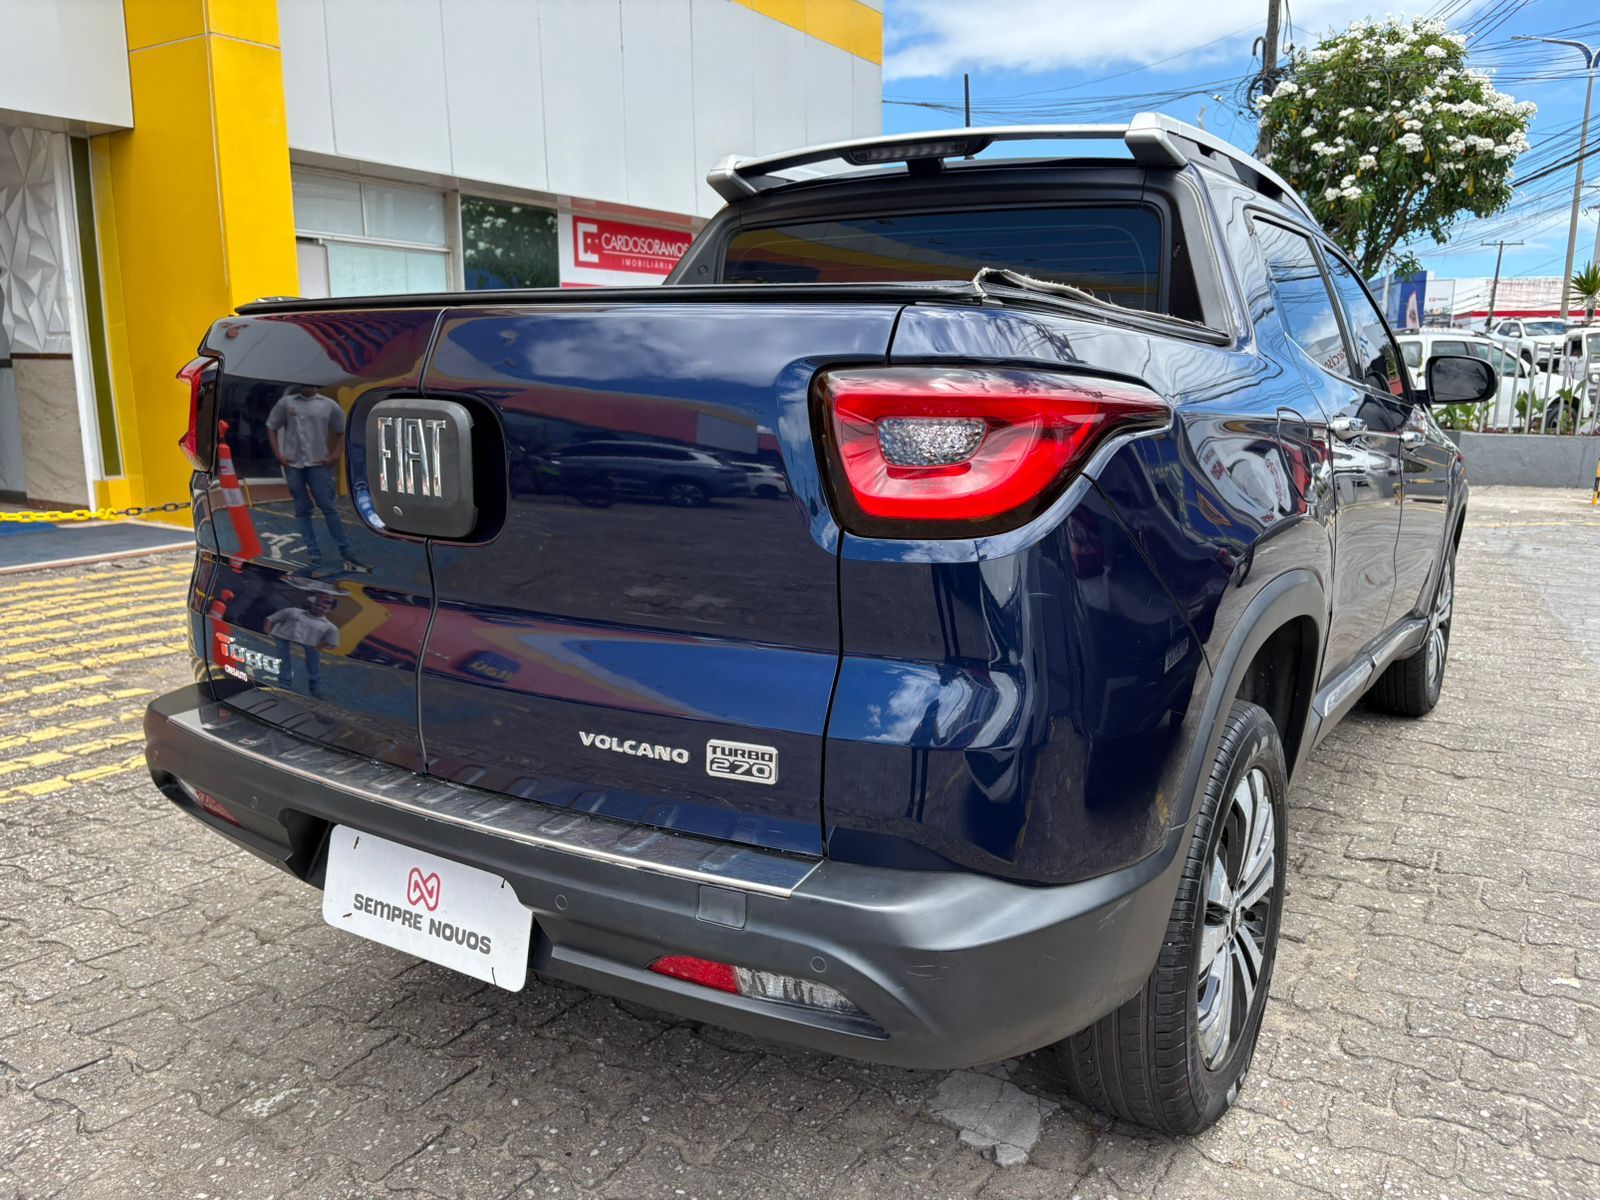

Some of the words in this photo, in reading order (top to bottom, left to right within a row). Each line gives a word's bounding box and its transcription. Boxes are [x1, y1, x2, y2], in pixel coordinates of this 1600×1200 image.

[621, 258, 673, 270] IMOBILIÁRIA
[378, 416, 446, 498] FIAT
[578, 731, 690, 764] VOLCANO
[708, 744, 773, 763] TURBO
[710, 758, 772, 779] 270
[353, 893, 423, 931] SEMPRE
[428, 918, 492, 955] NOVOS
